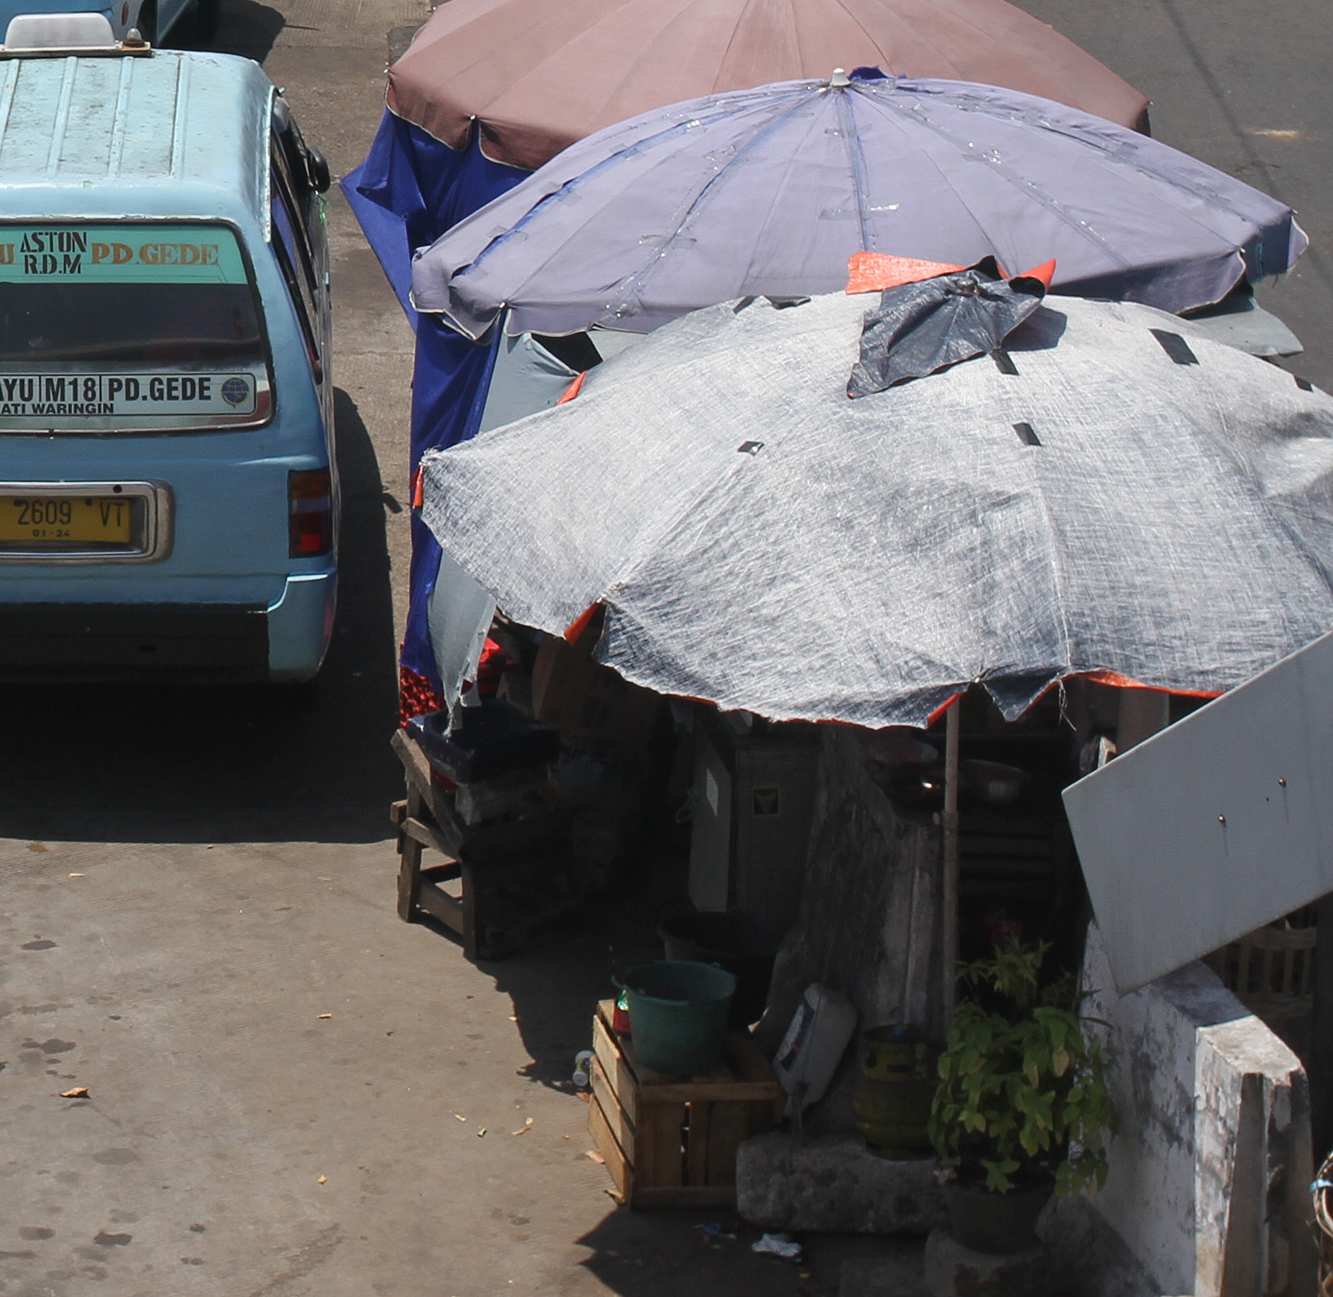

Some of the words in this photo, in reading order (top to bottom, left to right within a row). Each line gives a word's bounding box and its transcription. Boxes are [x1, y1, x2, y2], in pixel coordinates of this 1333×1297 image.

[20, 231, 88, 254] ASTON
[23, 254, 82, 275] R.D.M
[45, 377, 97, 402] M18
[108, 377, 212, 402] PD.GEDE
[31, 403, 114, 414] WARINGIN
[17, 501, 72, 527] 2609
[98, 502, 126, 528] VT
